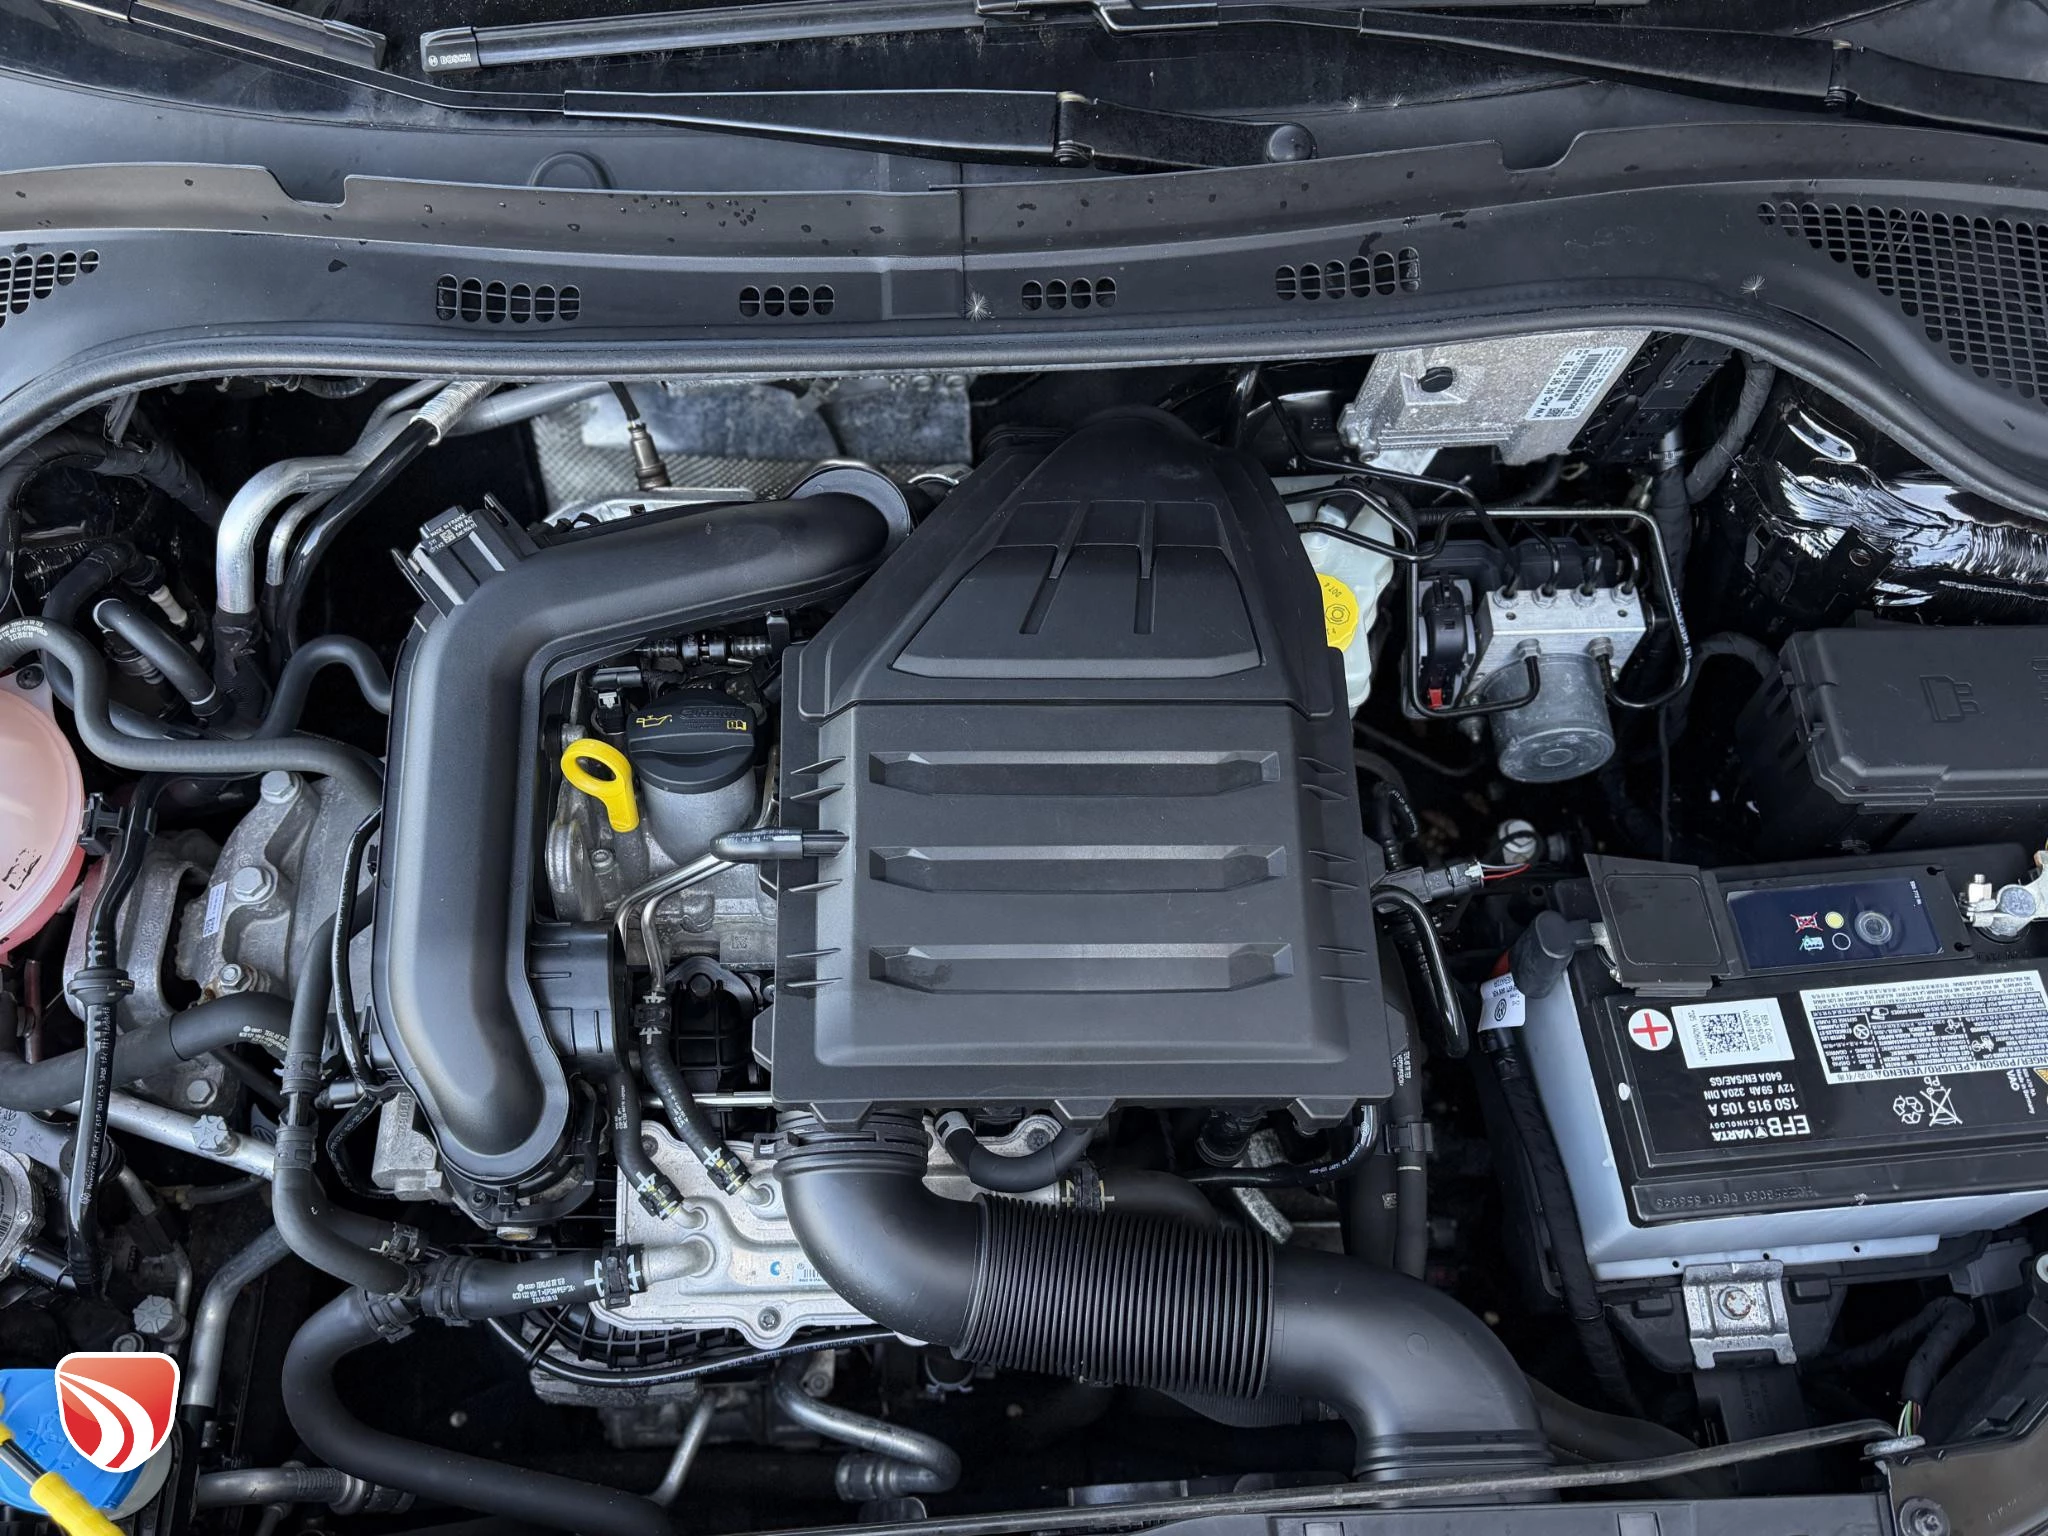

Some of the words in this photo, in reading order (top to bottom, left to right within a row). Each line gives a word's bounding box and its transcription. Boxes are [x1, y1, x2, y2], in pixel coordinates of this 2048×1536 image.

[439, 52, 471, 64] BOSCH
[1541, 396, 1554, 406] AG
[1328, 586, 1342, 598] DOT
[1979, 1056, 2048, 1070] NGER/POISON
[1882, 1062, 1969, 1078] PELIGRO/VENENO
[1708, 1073, 1758, 1087] EN/SAE/GS
[1757, 1071, 1783, 1083] 640A
[1923, 1075, 1940, 1087] Pb
[2006, 1069, 2020, 1091] VAO
[1720, 1087, 1746, 1099] 320A
[1749, 1085, 1774, 1096] 59Ah
[1777, 1083, 1796, 1094] 12V
[1703, 1089, 1721, 1101] DIN
[1707, 1103, 1718, 1117] A
[1720, 1101, 1746, 1116] 105
[1747, 1099, 1772, 1114] 915
[1709, 1118, 1765, 1130] TECHNOLOGY
[1766, 1114, 1811, 1137] EFB
[1711, 1128, 1755, 1142] VARTA
